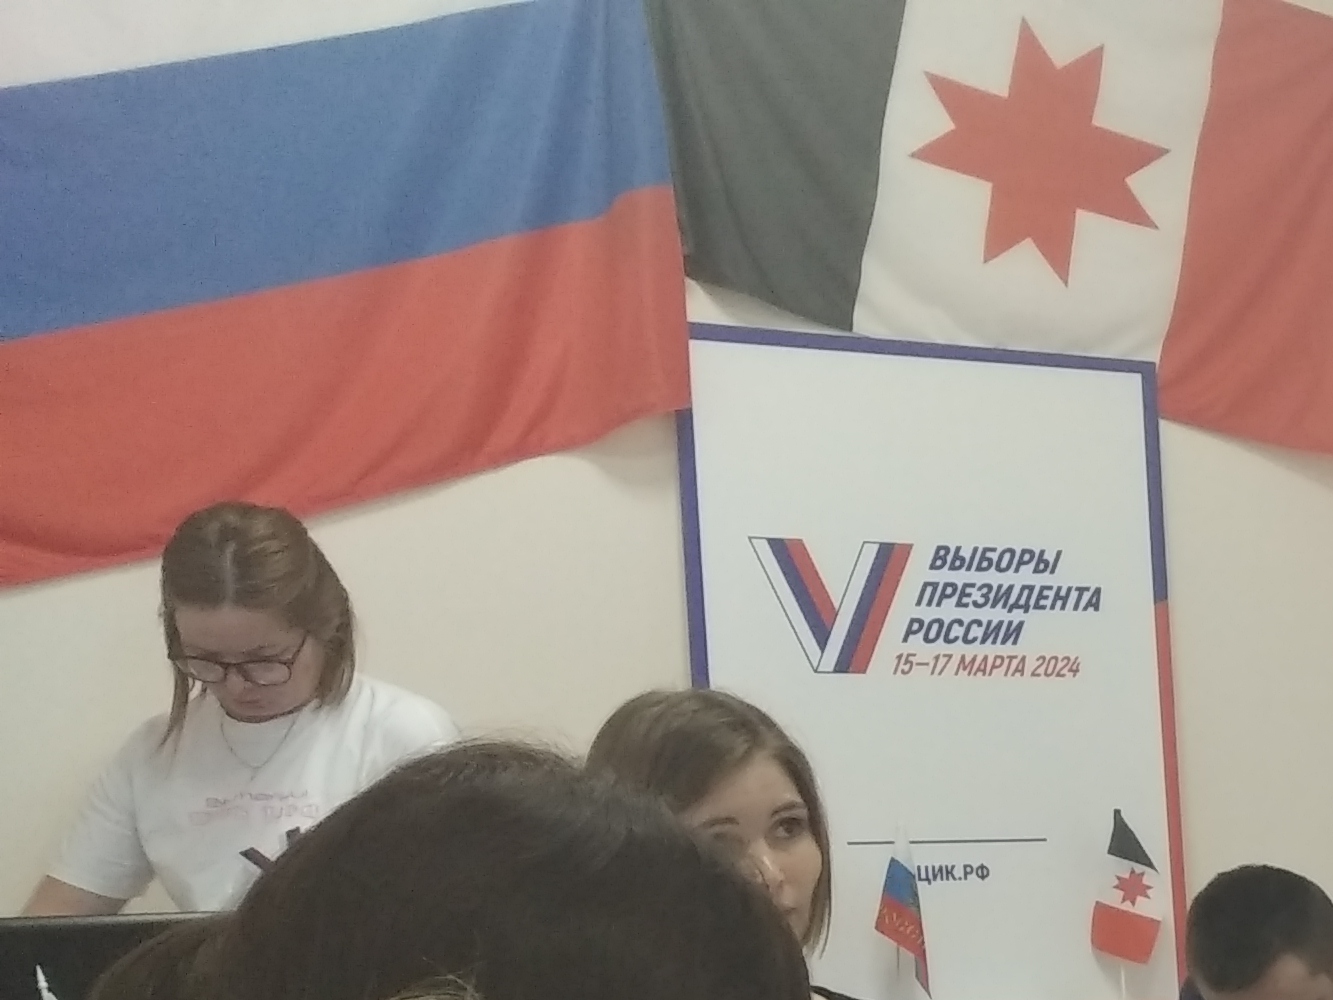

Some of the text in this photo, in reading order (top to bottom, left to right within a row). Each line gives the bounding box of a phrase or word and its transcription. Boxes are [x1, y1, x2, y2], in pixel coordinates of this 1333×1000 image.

[929, 545, 1062, 575] ВЫБОРЫ
[915, 581, 1102, 613] ПРЕЗИДЕНТА
[902, 617, 1025, 646] РОССИИ
[954, 654, 1027, 677] МАРТА
[1030, 655, 1081, 678] 2024
[916, 863, 990, 885] ЦИК.РФ
